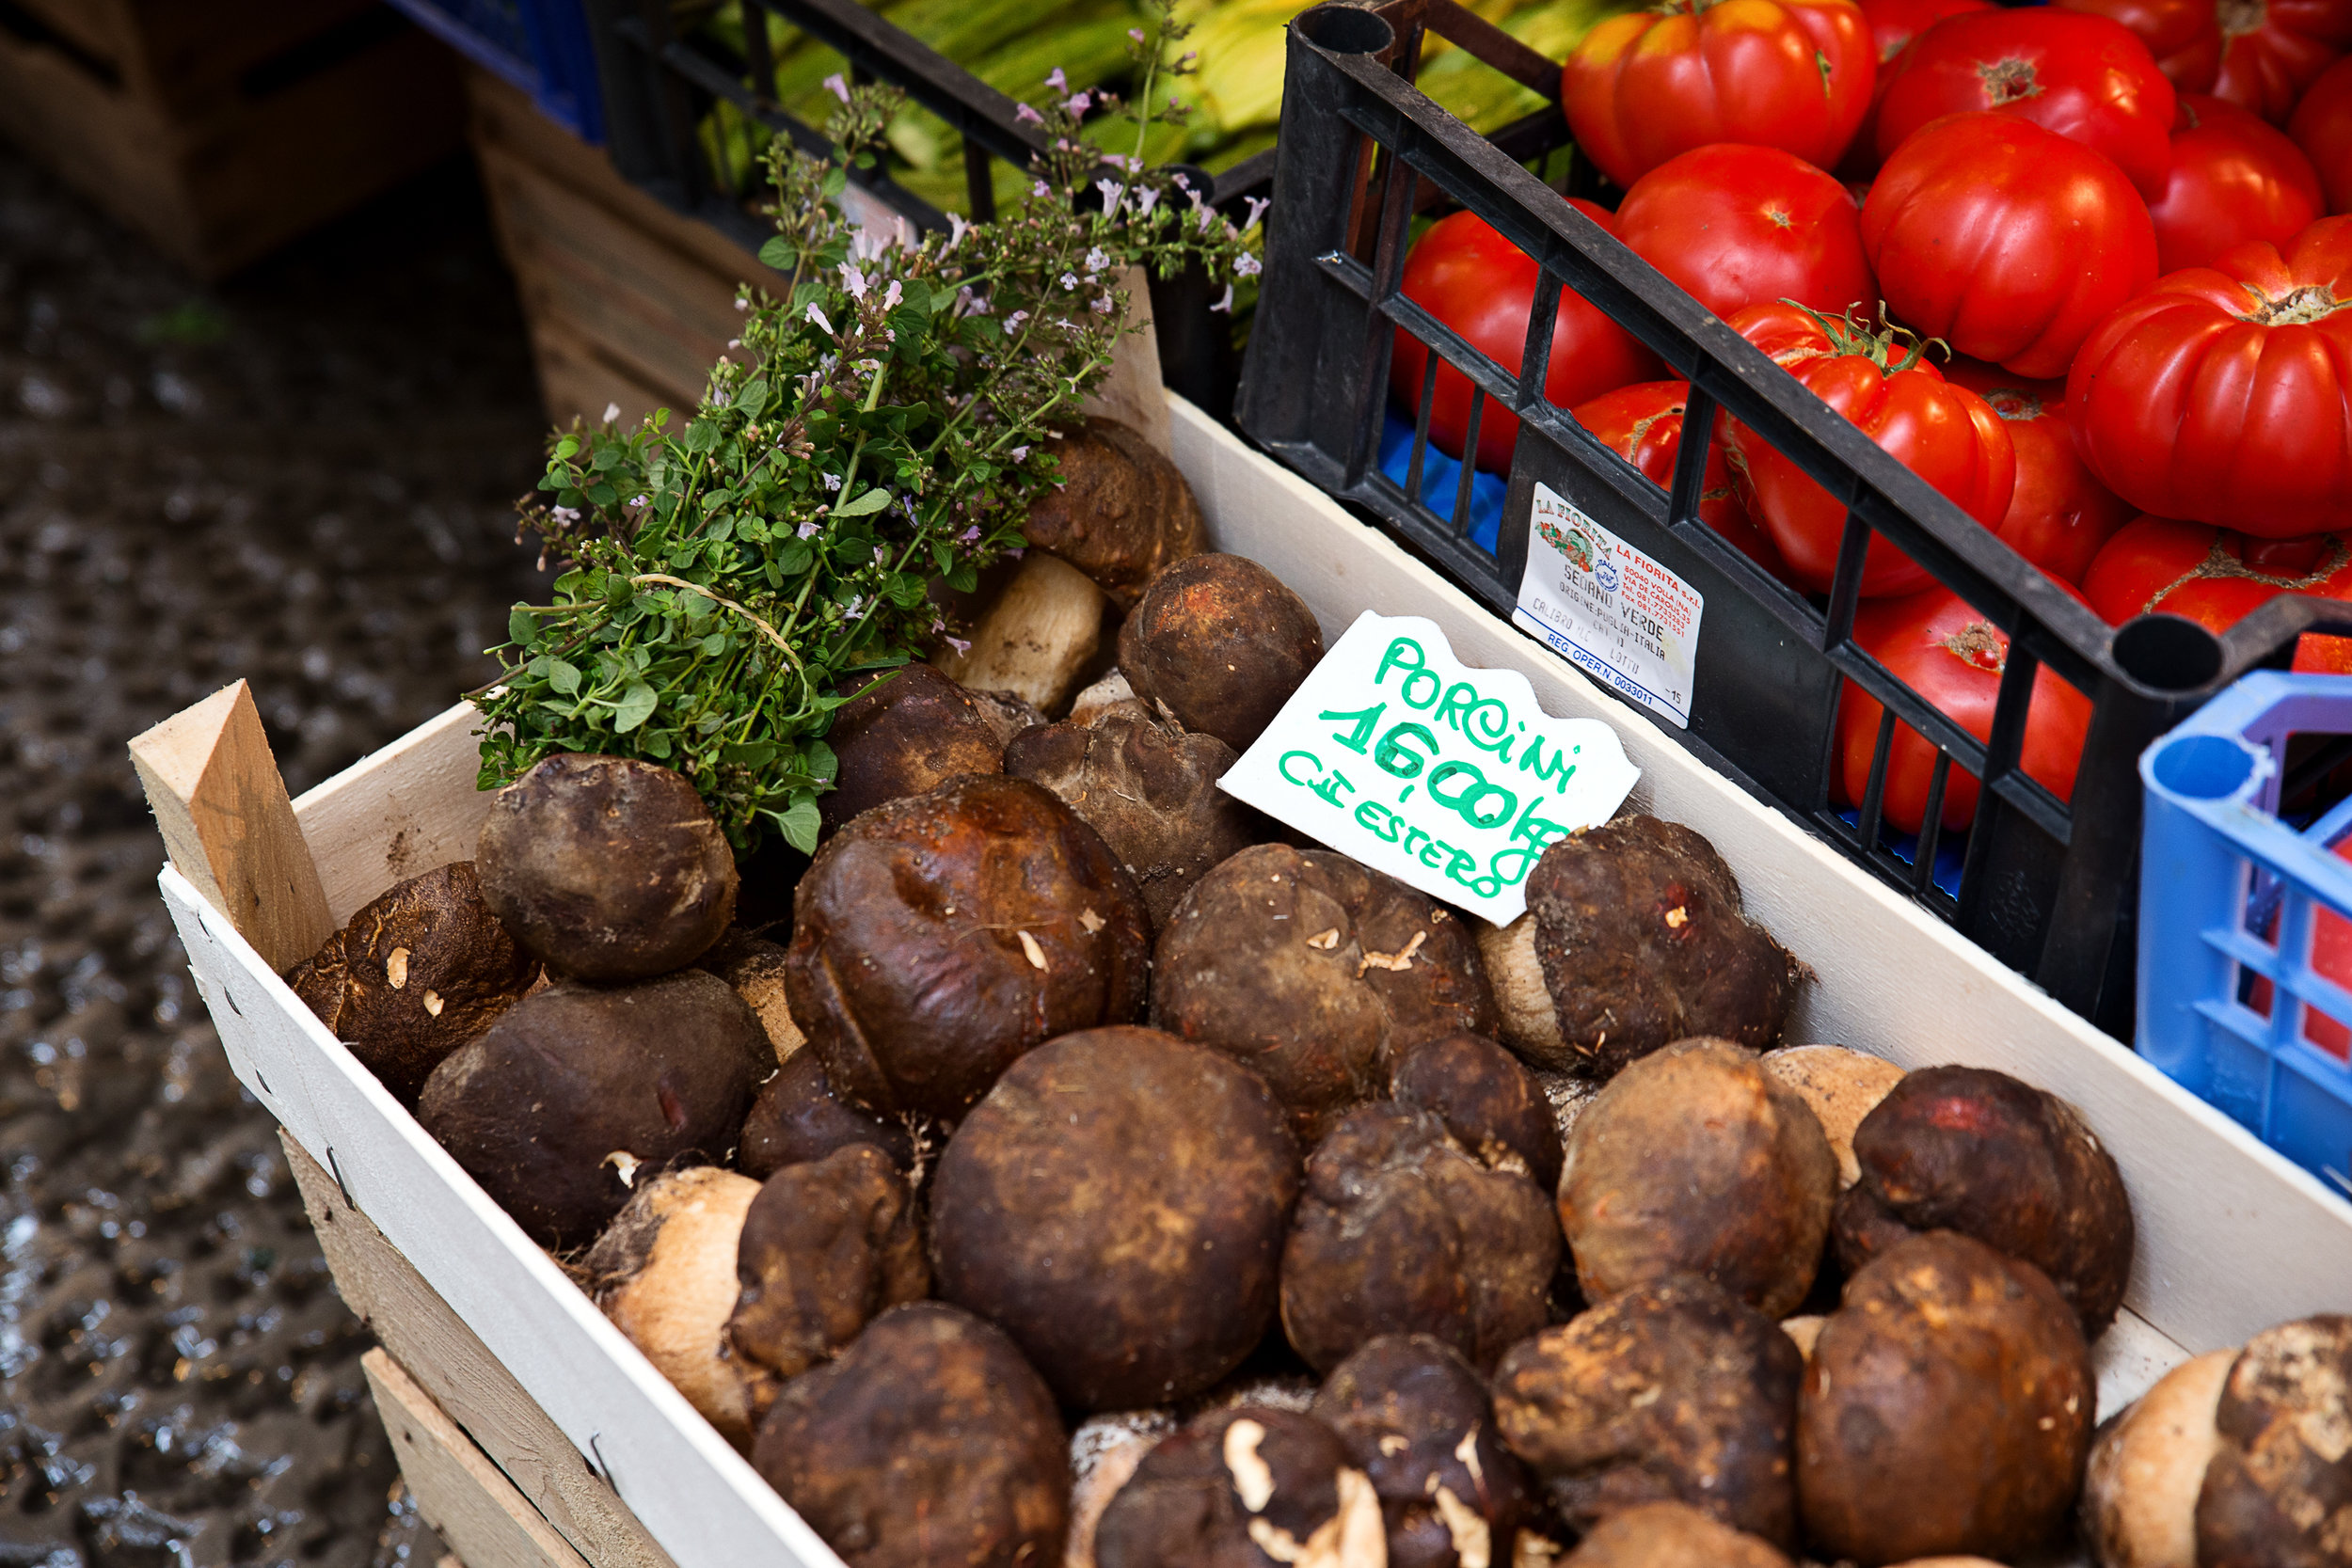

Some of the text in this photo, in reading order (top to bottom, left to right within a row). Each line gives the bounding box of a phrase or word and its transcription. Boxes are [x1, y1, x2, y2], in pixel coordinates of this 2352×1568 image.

[1536, 499, 1612, 561] LA FIORITA
[1565, 564, 1613, 608] SEDANO
[1621, 602, 1664, 642] VERDE
[1616, 544, 1700, 609] LA FIORITA s.r.l.
[1621, 591, 1635, 603] Fax
[1623, 582, 1635, 594] Tel.
[1624, 574, 1637, 586] VIA
[1639, 583, 1648, 594] DE
[1625, 565, 1692, 616] 80040 VOLLA (NA)
[1533, 597, 1573, 630] CALIBRO
[1548, 633, 1569, 655] REG.
[1614, 675, 1653, 705] 0033011
[1355, 800, 1502, 898] ESTERO
